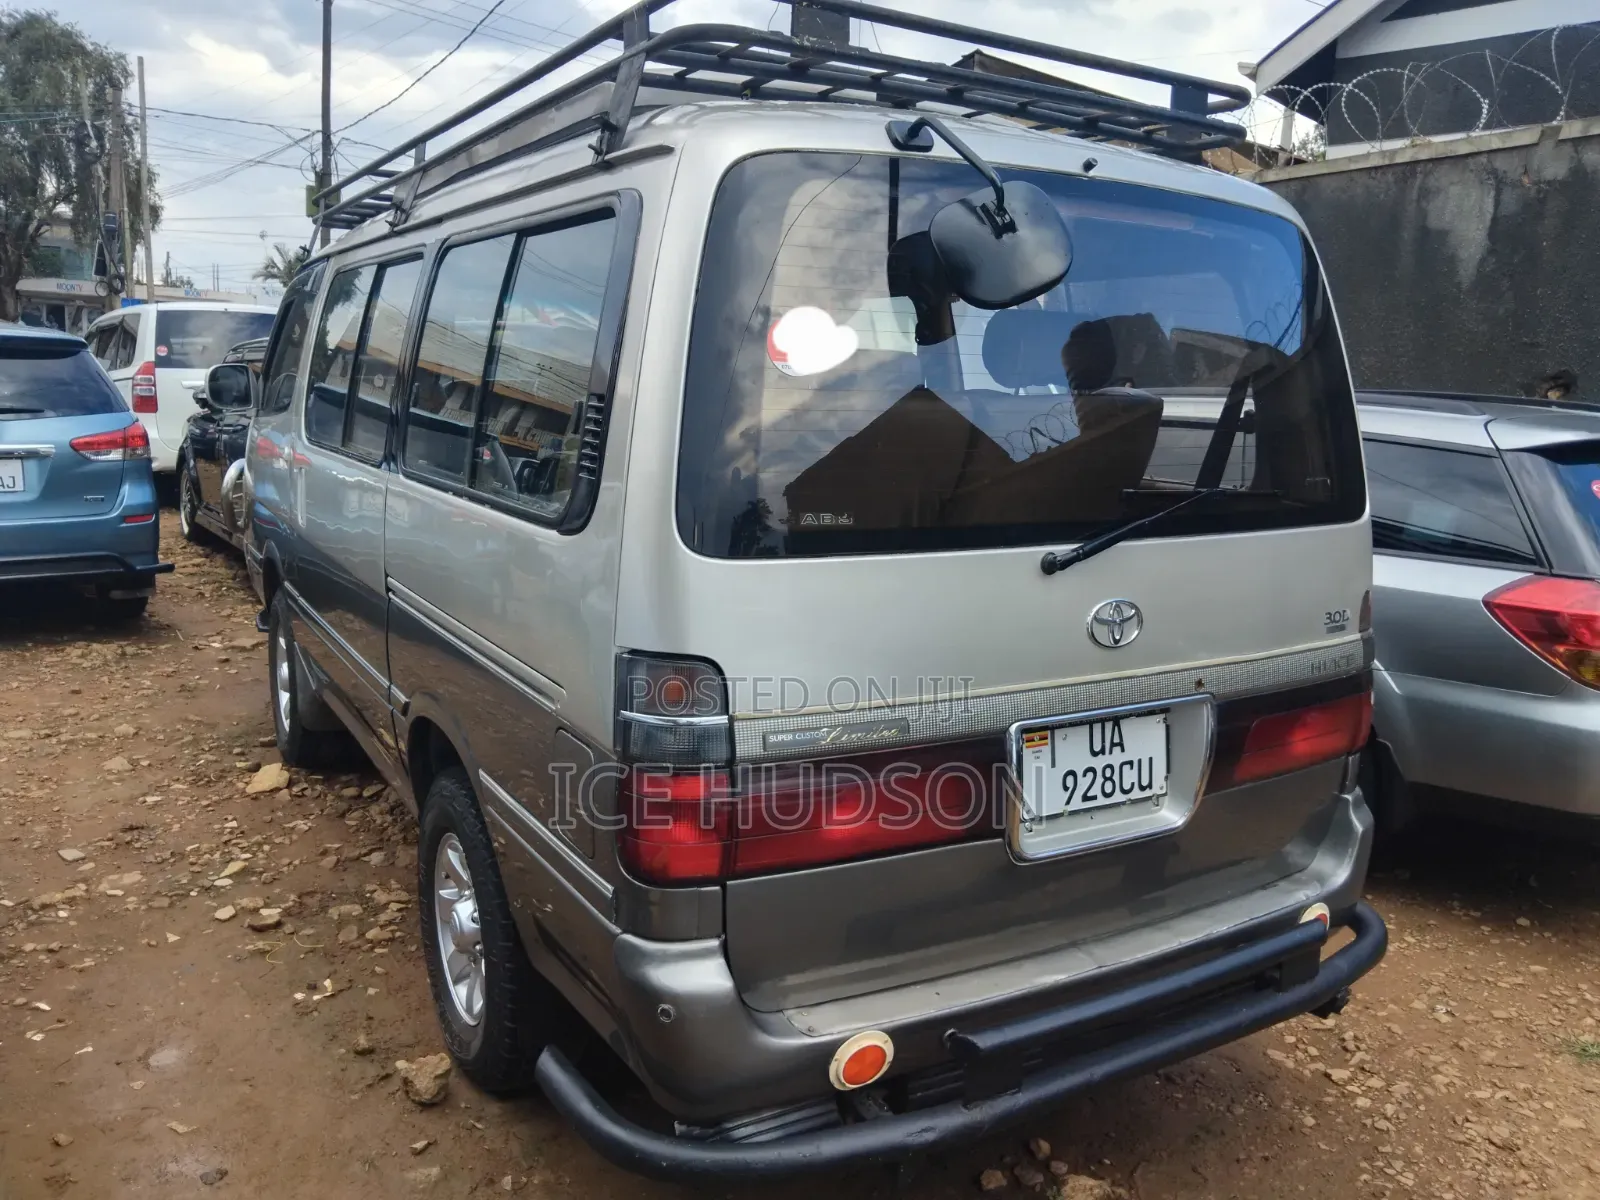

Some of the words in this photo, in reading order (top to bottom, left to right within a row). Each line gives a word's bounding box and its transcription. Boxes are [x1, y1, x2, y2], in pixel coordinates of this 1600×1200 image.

[768, 734, 793, 743] SUPER
[1089, 720, 1125, 757] UA
[1061, 756, 1154, 807] 928CU
